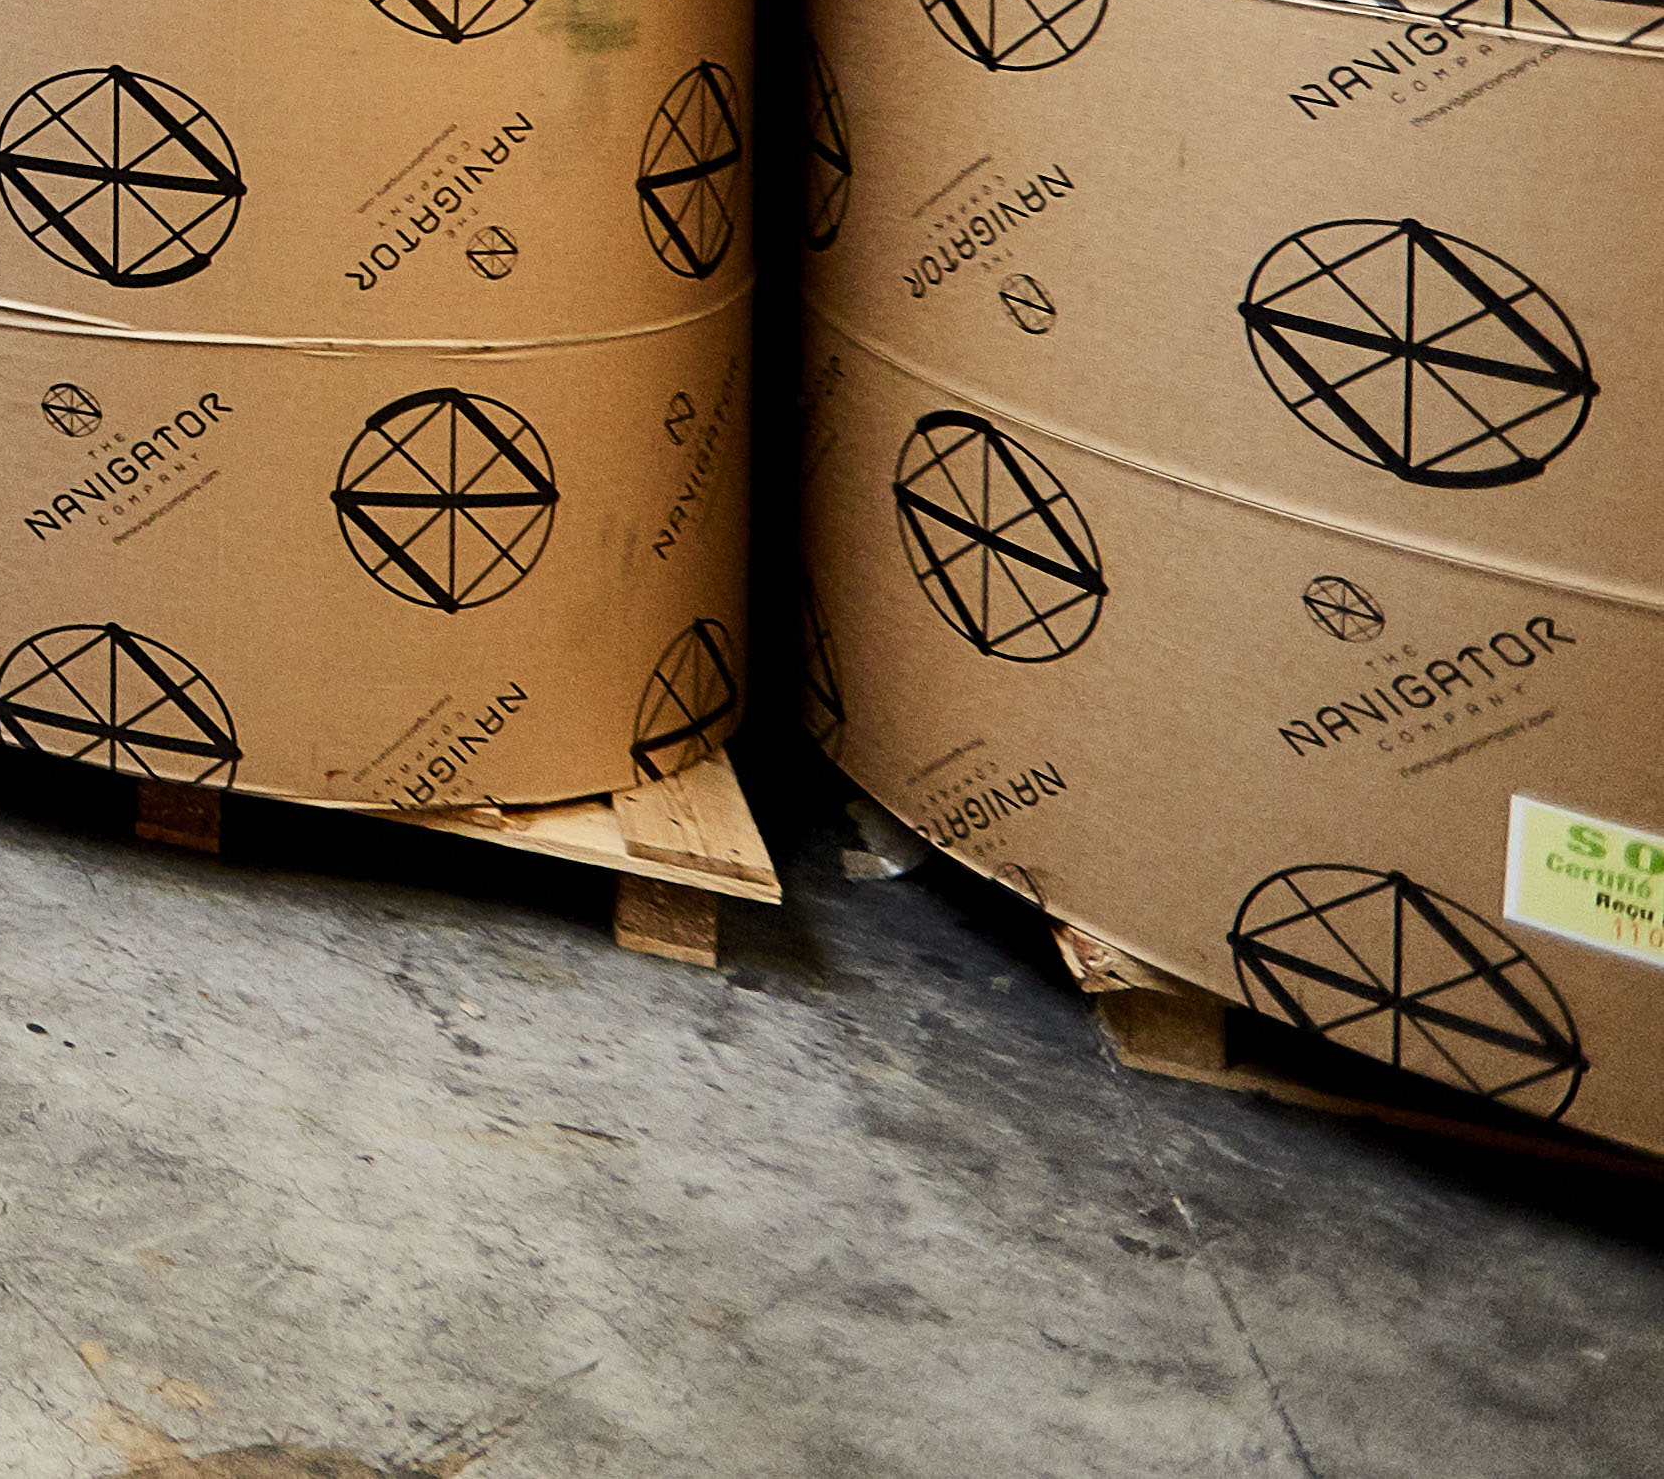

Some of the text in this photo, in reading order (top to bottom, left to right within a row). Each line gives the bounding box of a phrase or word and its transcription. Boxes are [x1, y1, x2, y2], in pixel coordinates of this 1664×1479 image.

[346, 111, 535, 292] NAVIGATOR
[903, 163, 1075, 300] NAVIGATOR
[24, 391, 232, 540] NAVIGATOR
[88, 431, 127, 461] THE
[96, 451, 203, 526] COMPANY
[1279, 616, 1576, 756] NAVIGATOR
[1365, 644, 1418, 669] THE
[1378, 685, 1529, 751] COMPANY
[1566, 823, 1664, 875] SO
